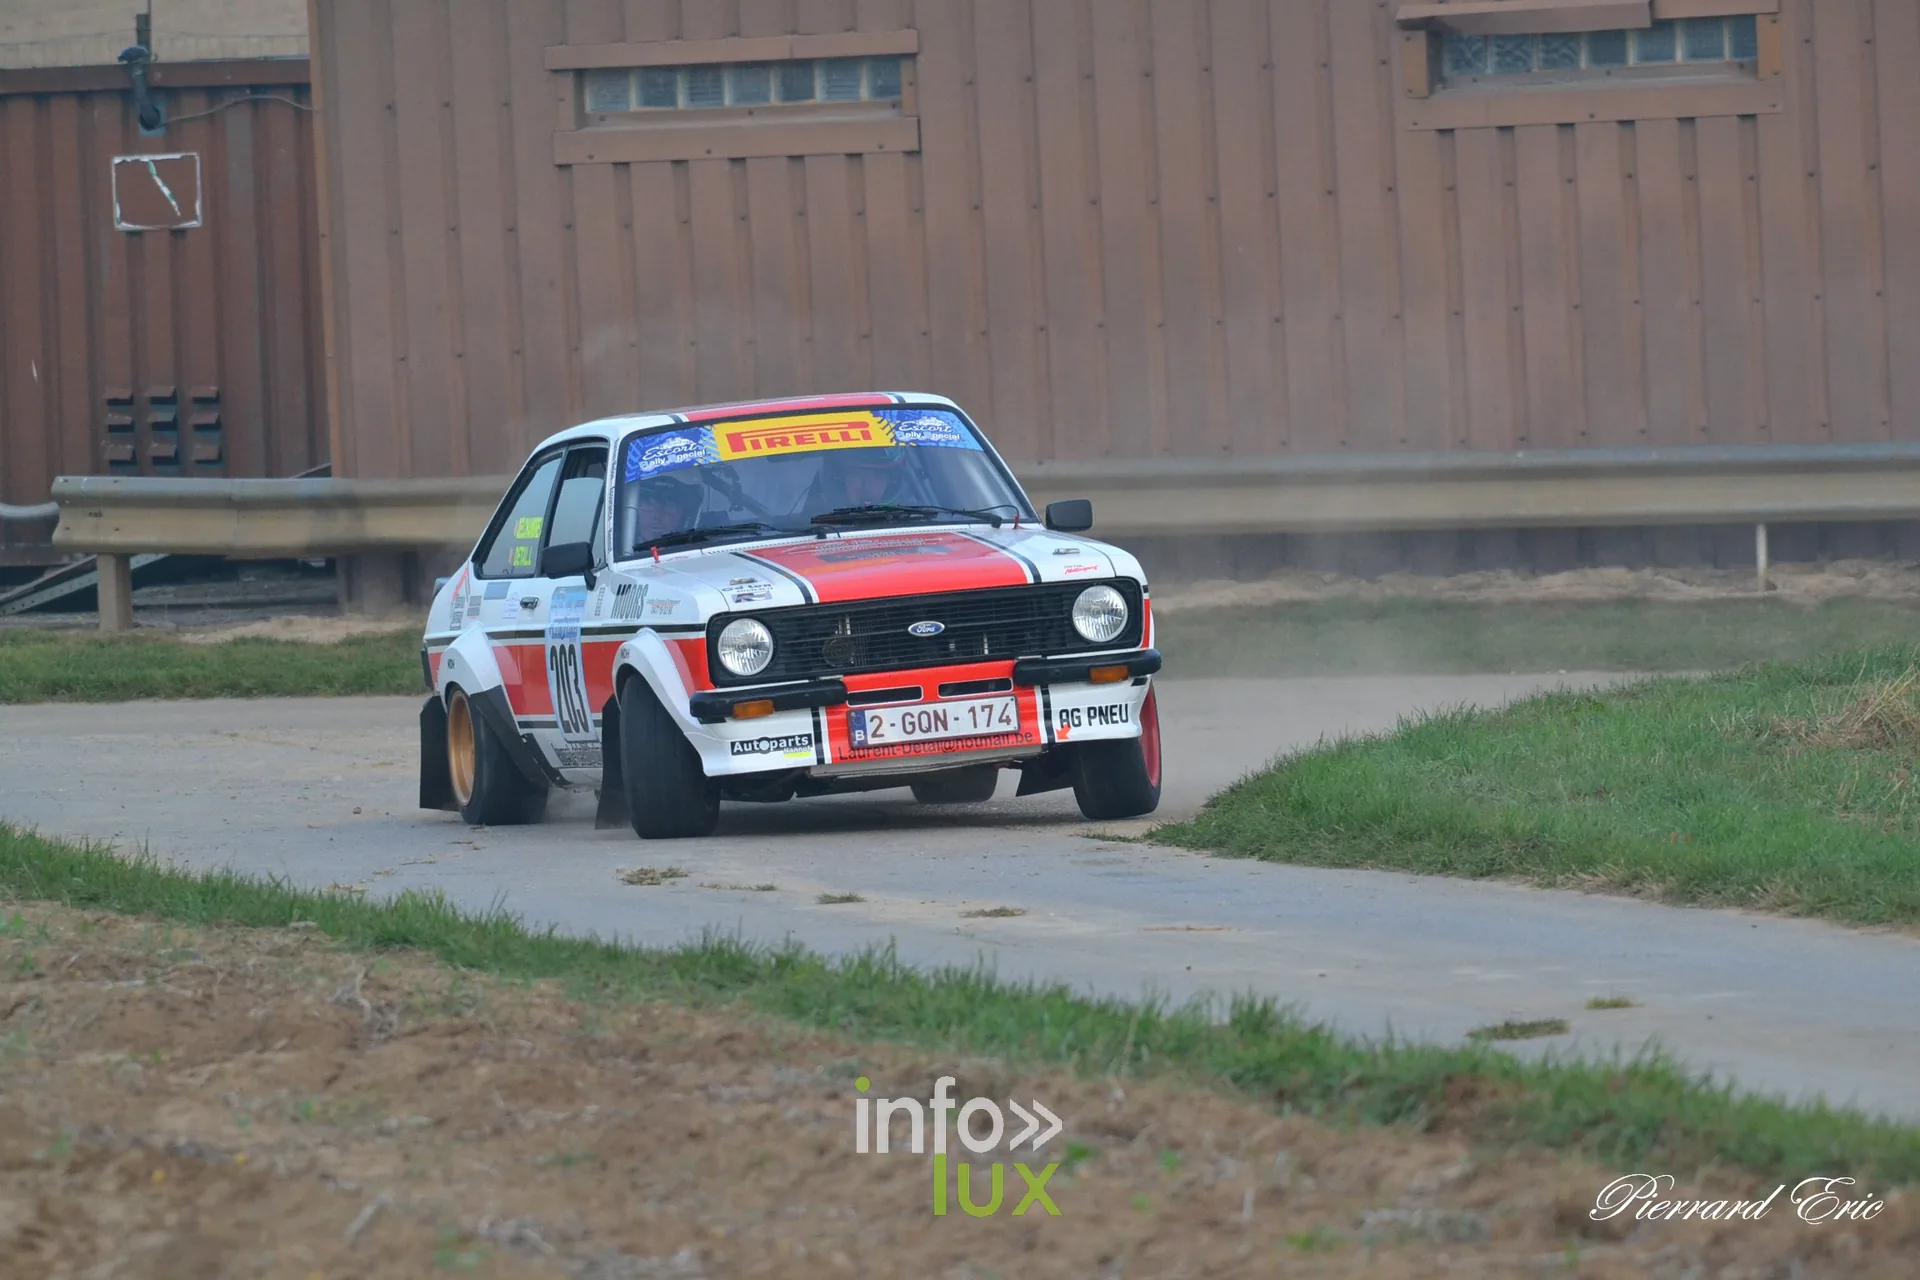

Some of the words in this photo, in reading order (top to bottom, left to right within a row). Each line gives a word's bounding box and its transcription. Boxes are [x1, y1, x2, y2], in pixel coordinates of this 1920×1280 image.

[899, 420, 953, 433] Escort
[725, 420, 874, 453] PIRELLI
[642, 442, 700, 460] Escort
[550, 643, 589, 734] 203
[1059, 708, 1082, 728] AG
[1087, 703, 1129, 726] PNEU
[732, 735, 809, 754] Autoparts
[855, 730, 865, 741] B
